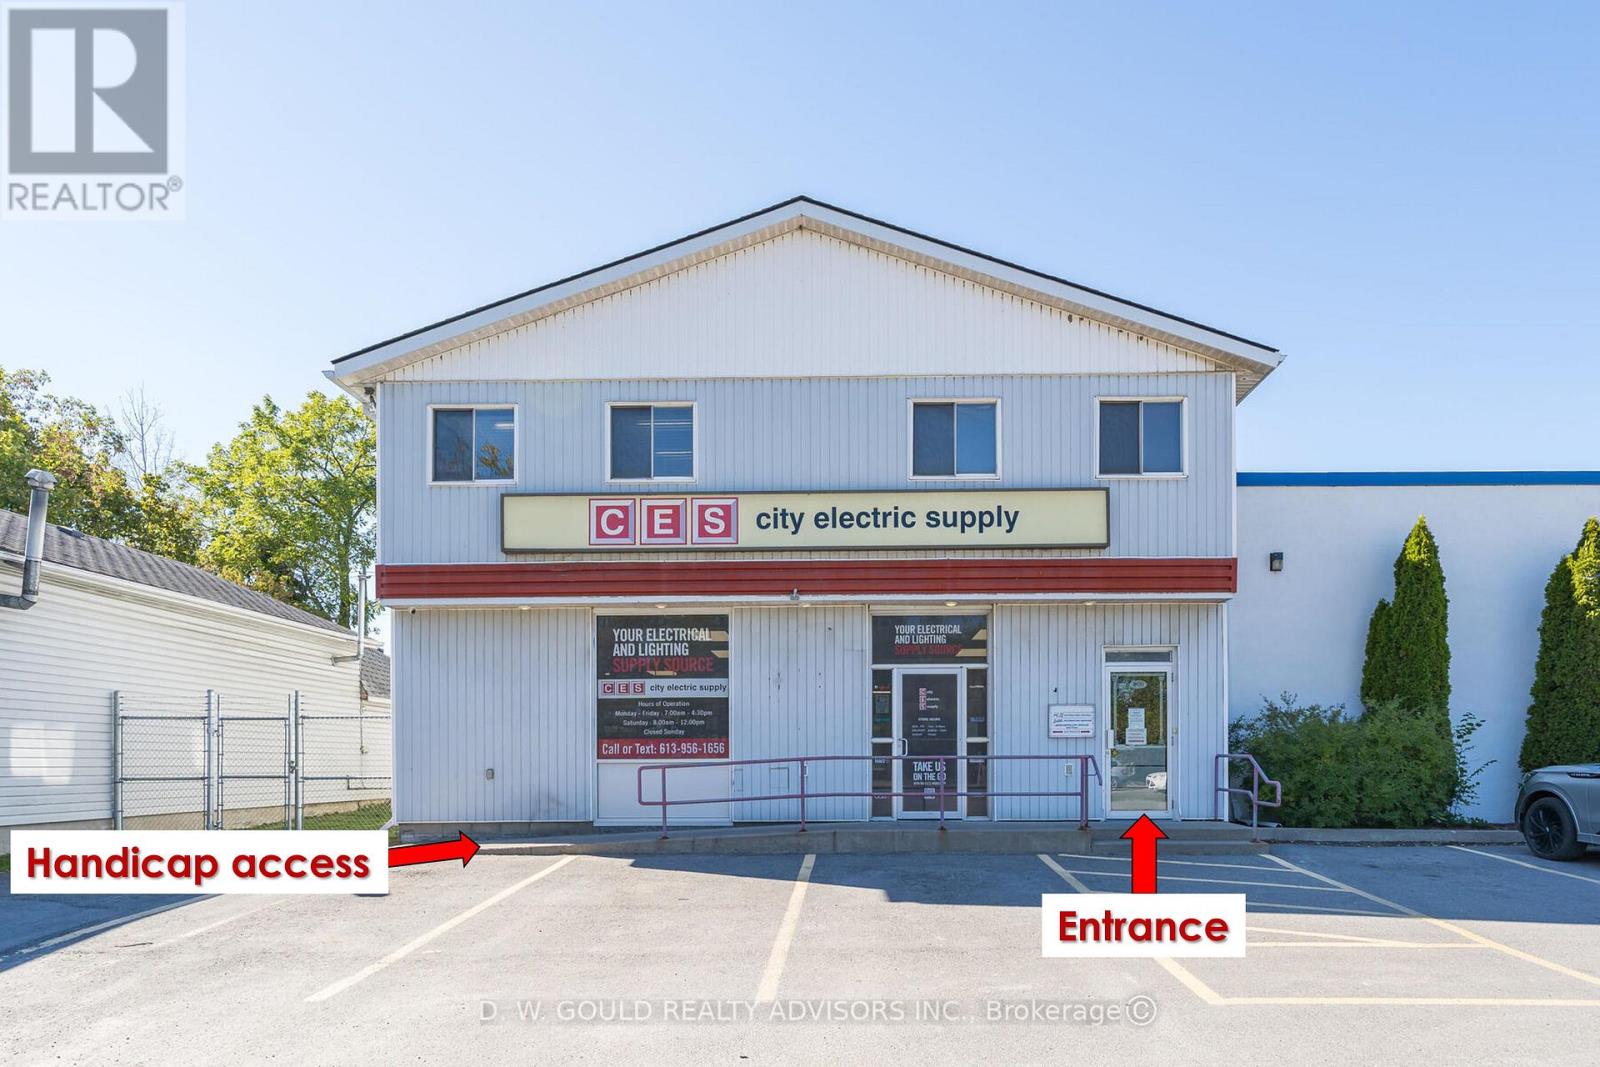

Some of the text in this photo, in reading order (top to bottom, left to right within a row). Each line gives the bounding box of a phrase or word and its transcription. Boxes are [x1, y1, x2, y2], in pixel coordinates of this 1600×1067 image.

[755, 507, 805, 535] city
[813, 505, 916, 529] electric
[925, 505, 1020, 533] supply
[613, 627, 712, 642] YOUR ELECTRICAL
[894, 624, 962, 634] YOUR ELECTRICAL
[894, 635, 947, 644] AND LIGHTING
[613, 643, 689, 656] AND LIGHTING
[613, 656, 713, 672] SUPPLY SOURCE
[650, 684, 665, 692] city
[667, 683, 697, 691] electric
[699, 683, 727, 692] supply
[602, 742, 725, 755] Call or Text: 613-956-1656
[912, 761, 933, 771] TAKE
[913, 772, 923, 781] ON
[923, 772, 936, 781] THE
